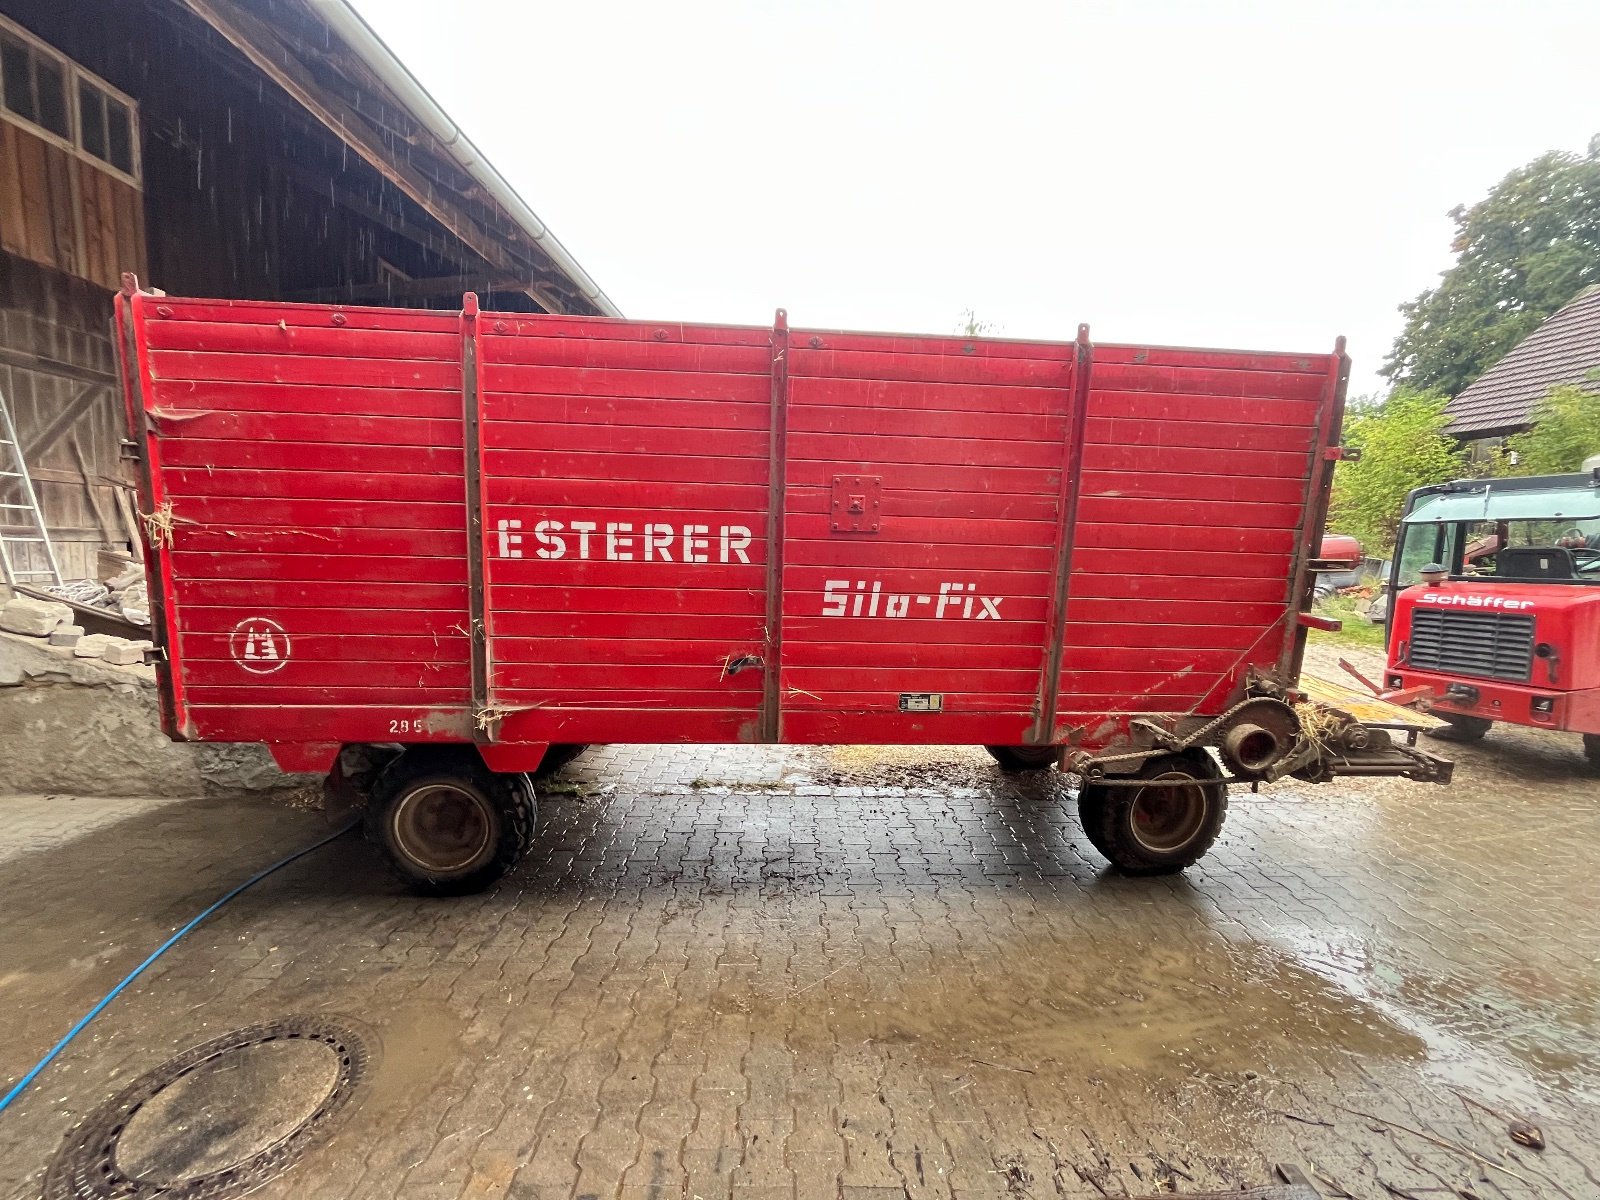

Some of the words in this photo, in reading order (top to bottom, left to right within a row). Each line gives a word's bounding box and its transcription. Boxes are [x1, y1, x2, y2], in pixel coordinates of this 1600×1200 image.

[497, 519, 752, 564] ESTERER
[822, 580, 1003, 620] Silo-Fix
[1415, 593, 1535, 609] Schäffer
